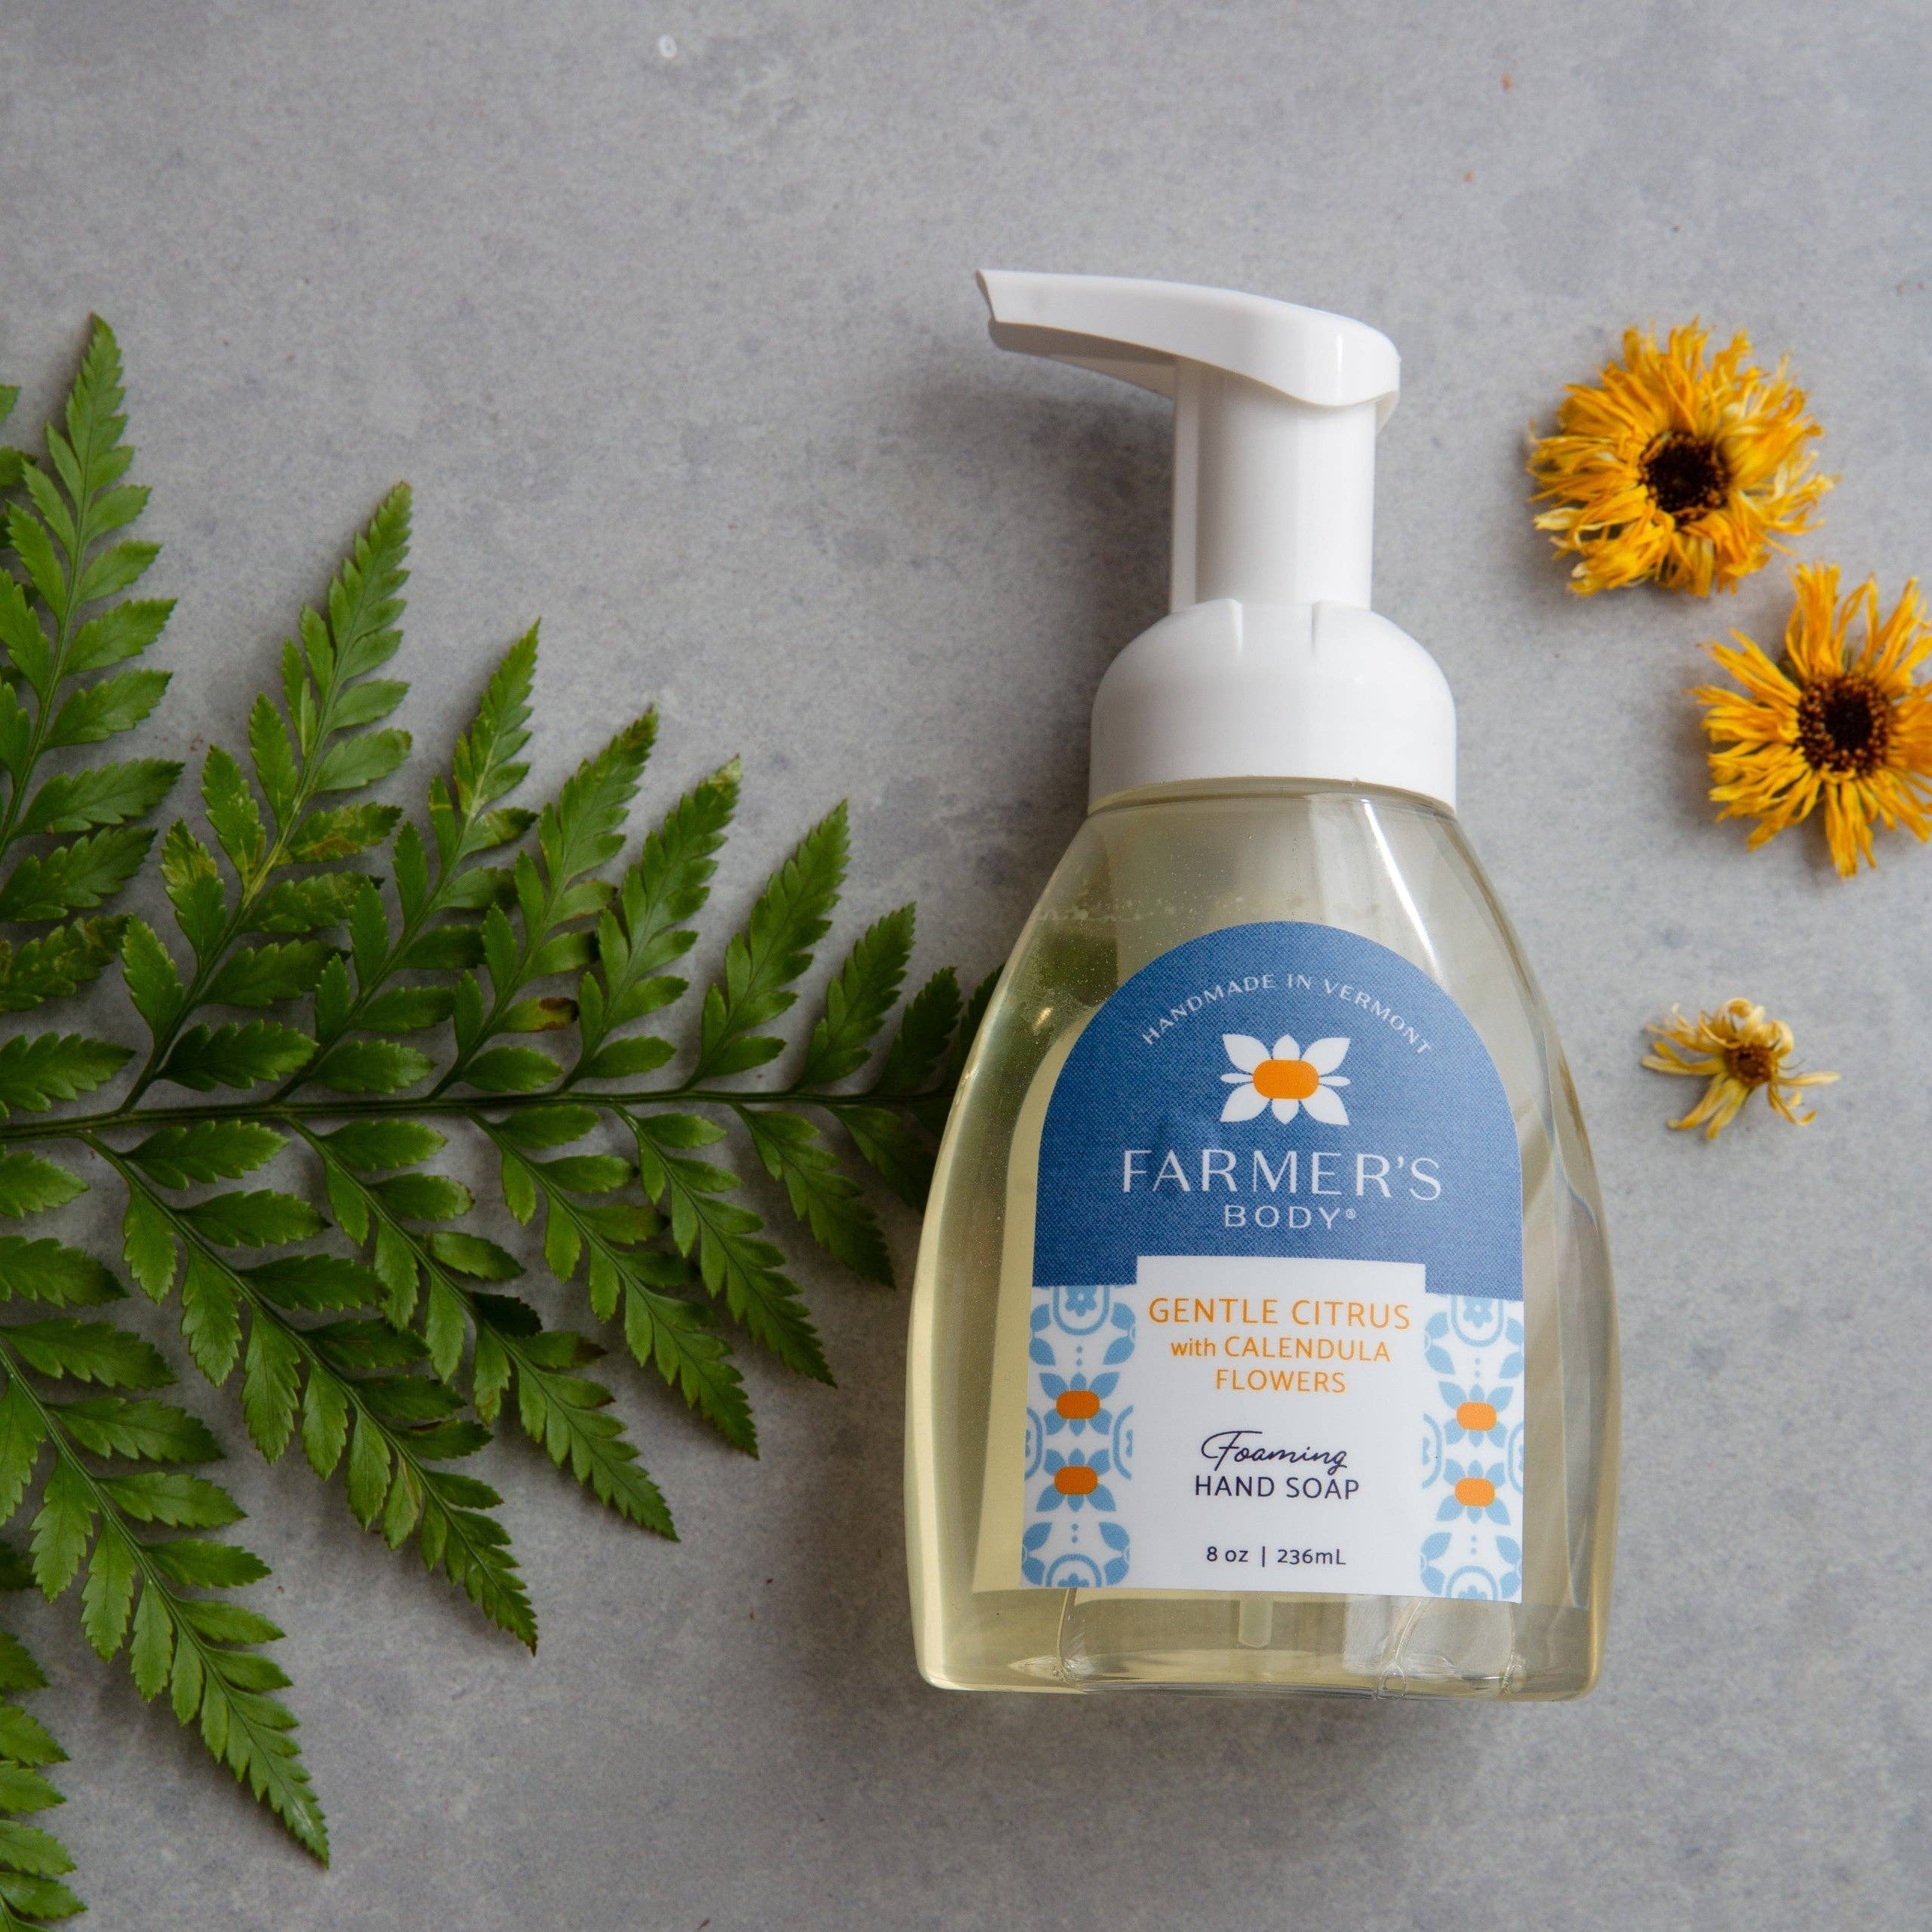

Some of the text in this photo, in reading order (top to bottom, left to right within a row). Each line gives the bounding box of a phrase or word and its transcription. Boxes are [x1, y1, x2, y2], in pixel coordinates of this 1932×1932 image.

[1142, 974, 1432, 1054] HANDMADE IN VERMONT
[1123, 1149, 1442, 1201] FARMER'S
[1149, 1297, 1411, 1330] GENTLE CITRUS
[1171, 1337, 1390, 1362] with CALENDULA
[1216, 1368, 1346, 1394] FLOWERS
[1201, 1430, 1348, 1475] Foaming
[1195, 1475, 1360, 1500] HAND SOAP
[1206, 1546, 1217, 1564] 8
[1225, 1550, 1248, 1564] oz
[1277, 1548, 1346, 1566] 236mL
